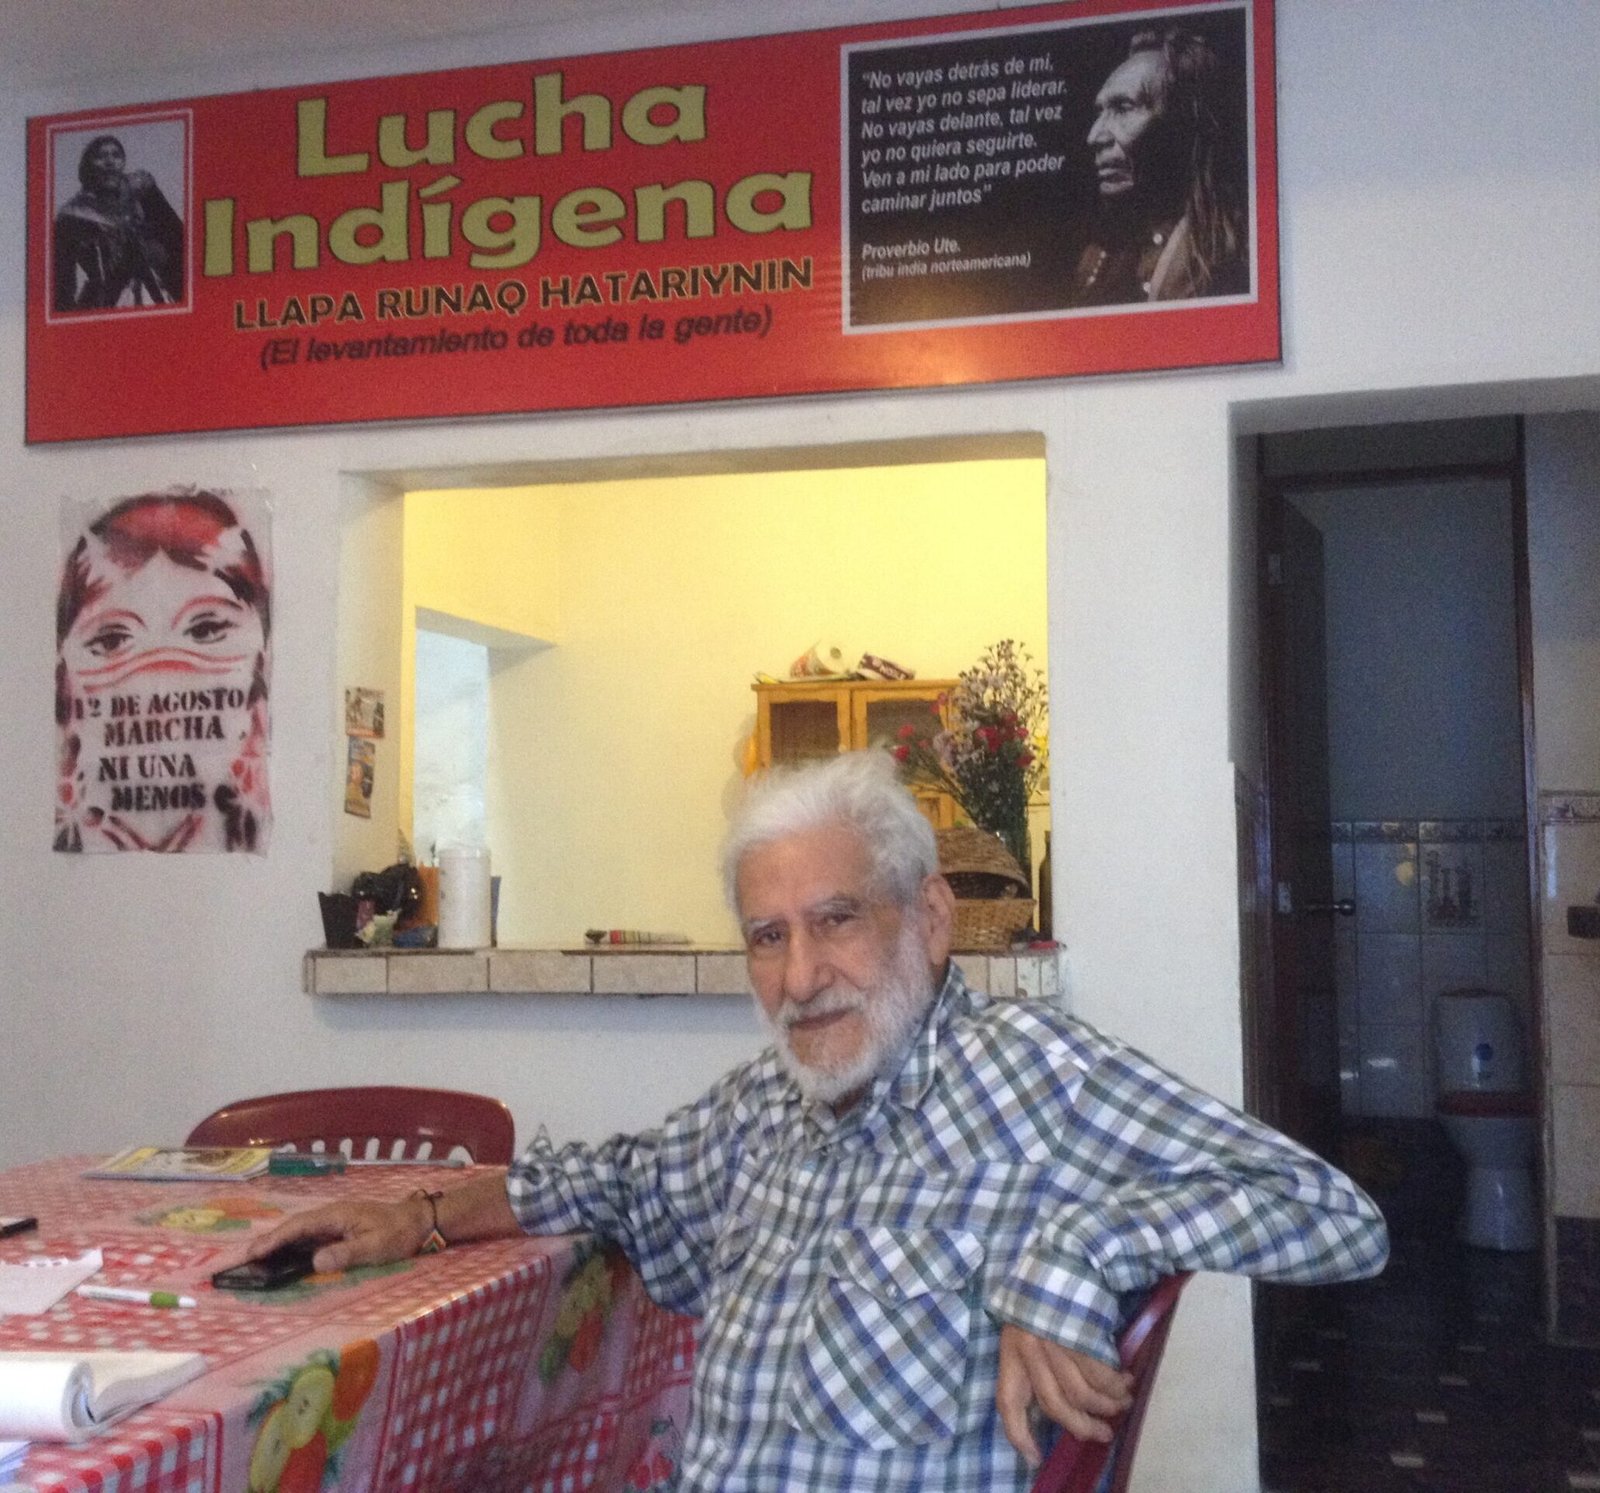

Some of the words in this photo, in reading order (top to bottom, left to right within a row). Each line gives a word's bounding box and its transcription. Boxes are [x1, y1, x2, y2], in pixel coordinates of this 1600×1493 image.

[897, 67, 943, 89] vayas
[1004, 56, 1025, 75] de
[861, 96, 881, 115] tal
[886, 95, 912, 112] vez
[917, 94, 937, 113] yo
[942, 91, 962, 106] no
[967, 86, 1006, 106] sepa
[296, 72, 706, 178] Lucha
[861, 121, 884, 139] No
[889, 118, 935, 139] vayas
[1009, 105, 1030, 124] tal
[1035, 104, 1063, 121] vez
[861, 148, 881, 168] yo
[885, 145, 906, 161] no
[911, 139, 961, 162] quiera
[862, 171, 891, 188] Ven
[896, 172, 905, 185] a
[910, 164, 931, 184] mi
[935, 161, 970, 181] lado
[974, 160, 1011, 181] para
[1015, 153, 1066, 178] poder
[861, 191, 927, 214] caminar
[202, 170, 814, 279] Indígena
[862, 239, 930, 260] Proverbio
[862, 262, 894, 282] (tribu
[898, 257, 928, 276] india
[930, 251, 1031, 274] norteamericana)
[234, 290, 366, 332] LLAPA
[375, 278, 528, 322] RUNAQ
[540, 256, 813, 309] HATARIYNIN
[260, 337, 300, 370] (El
[305, 326, 508, 363] levantamiento
[517, 323, 555, 348] de
[563, 317, 629, 346] toda
[639, 313, 665, 341] la
[674, 303, 773, 345] gente)
[111, 695, 141, 717] DE
[148, 687, 244, 715] AGOSTO
[104, 715, 225, 747] MARCHA
[99, 755, 129, 782] NI
[138, 753, 196, 778] UNA
[111, 782, 206, 812] MENOS
